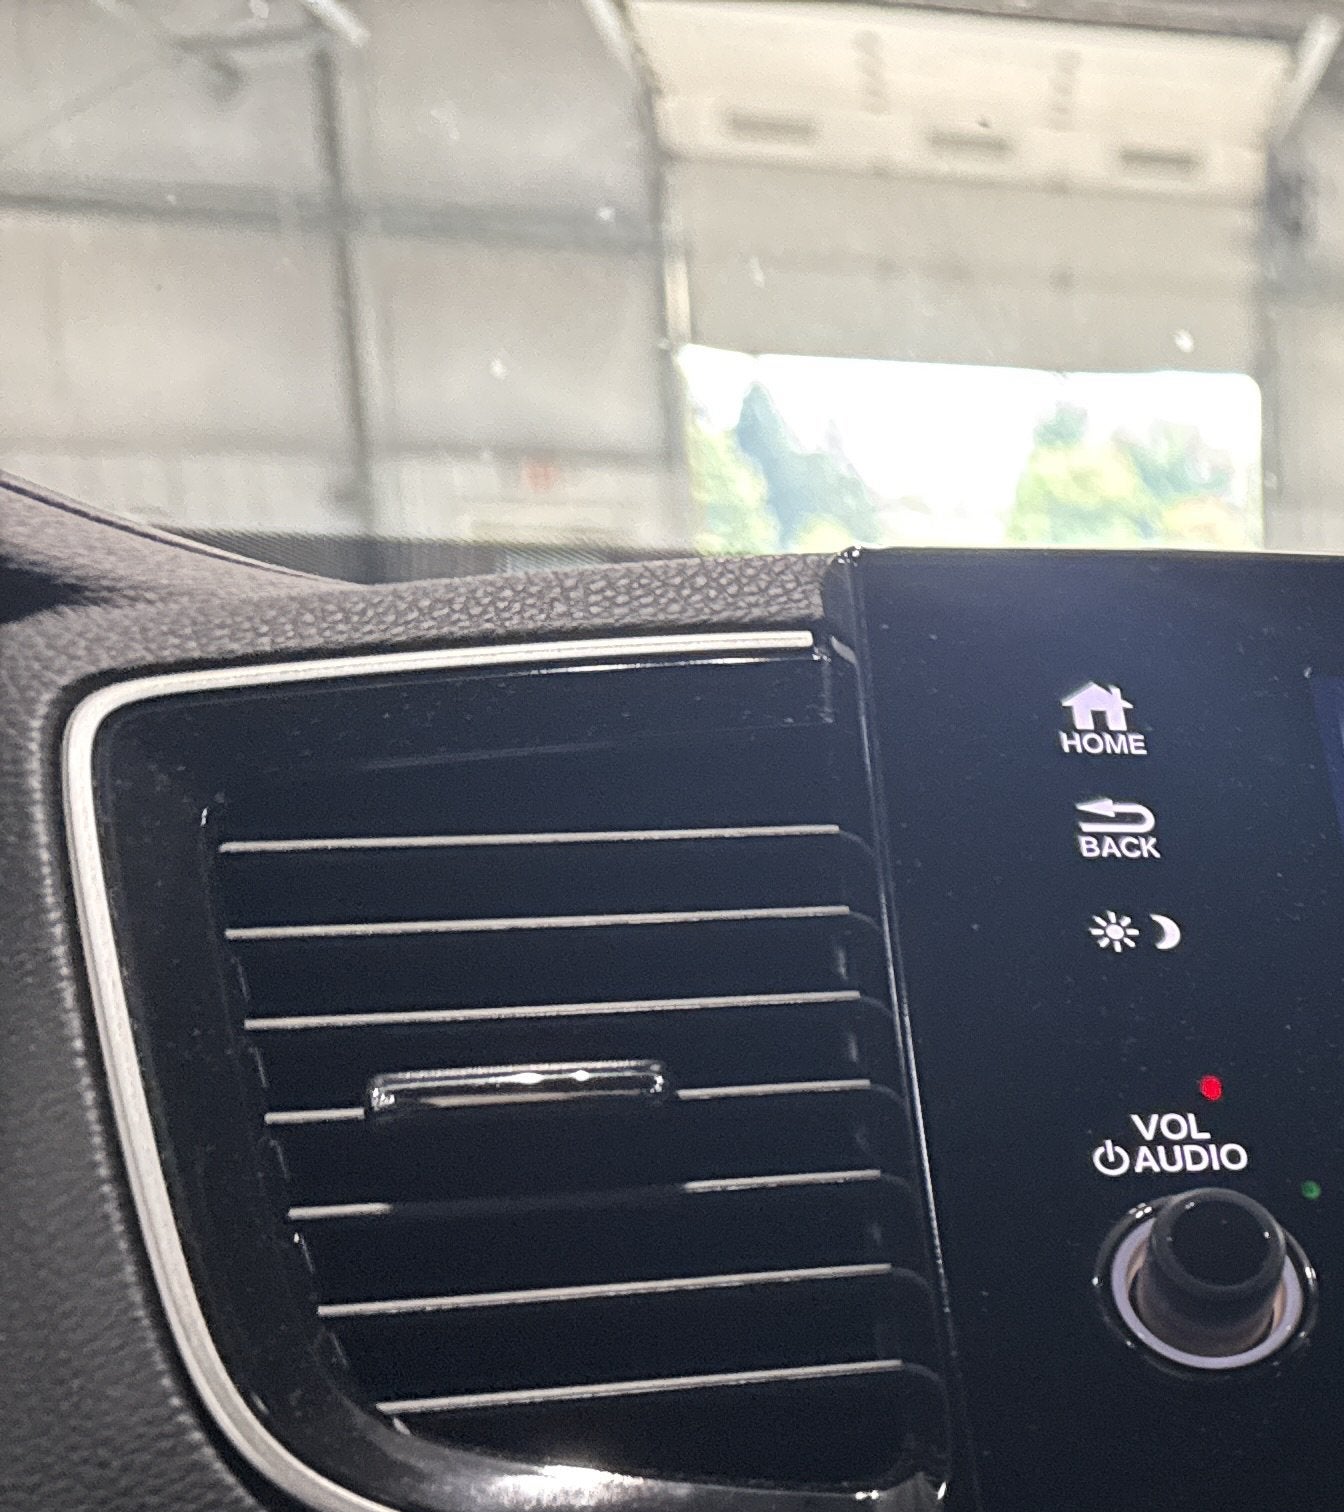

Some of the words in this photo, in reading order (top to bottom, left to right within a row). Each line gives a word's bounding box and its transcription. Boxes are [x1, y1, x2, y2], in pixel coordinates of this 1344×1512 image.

[1060, 731, 1147, 755] HOME
[1078, 836, 1160, 859] BACK
[1131, 1113, 1211, 1140] VOL
[1134, 1143, 1248, 1173] AUDIO
